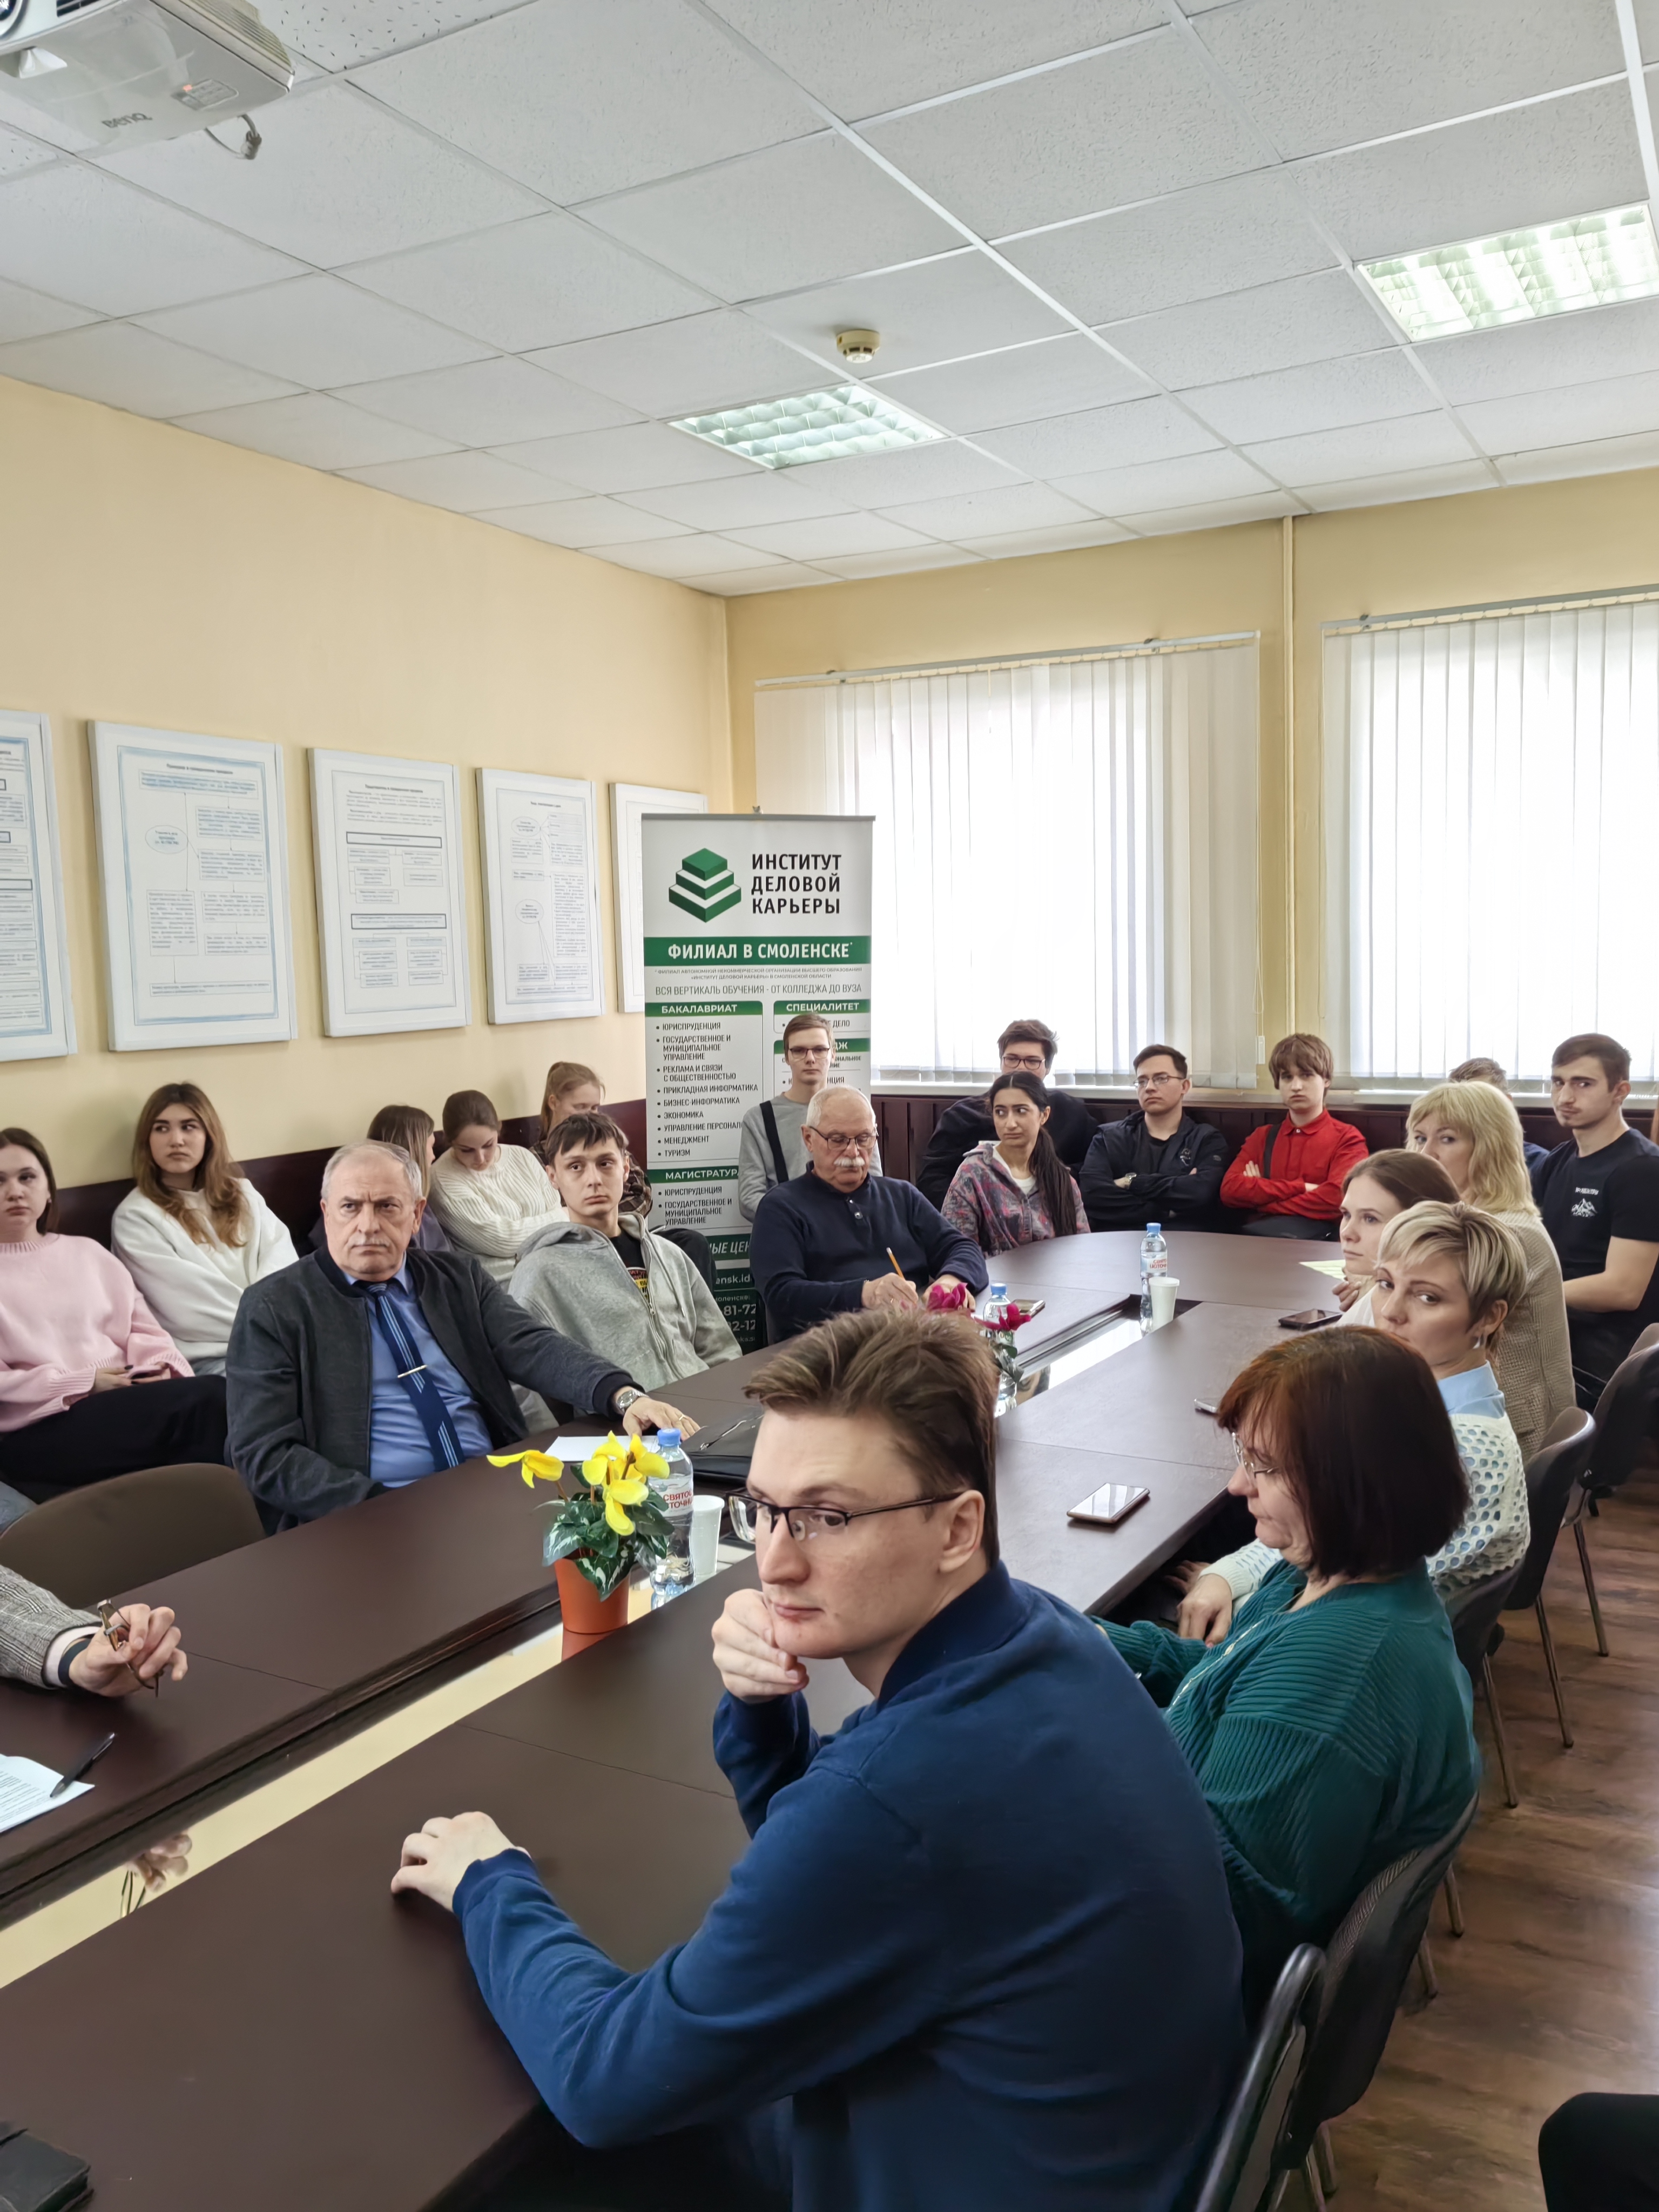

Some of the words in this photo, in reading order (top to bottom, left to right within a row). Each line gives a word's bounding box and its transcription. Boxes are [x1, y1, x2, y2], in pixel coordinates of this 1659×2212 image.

[101, 112, 152, 128] BenQ
[752, 854, 841, 870] ИНСТИТУТ
[751, 873, 840, 895] ДЕЛОВОЙ
[752, 898, 840, 914] КАРЬЕРЫ
[668, 944, 737, 959] ФИЛИАЛ
[744, 944, 752, 958] В
[656, 987, 671, 995] ВСЯ
[674, 986, 720, 995] ВЕРТИКАЛЬ
[723, 985, 764, 994] ОБУЧЕНИЯ
[771, 985, 781, 994] ОТ
[783, 984, 827, 994] КОЛЛЕДЖА
[829, 984, 840, 994] ДО
[842, 984, 861, 993] ВУЗА
[662, 1004, 738, 1014] БАКАЛАВРИАТ
[786, 1003, 859, 1013] СПЕЦИАЛИТЕТ
[662, 1022, 721, 1031] ЮРИСПРУДЕНЦИЯ
[663, 1035, 725, 1044] ГОСУДАРСТВЕННОЕ
[663, 1043, 721, 1053] МУНИЦИПАЛЬНОЕ
[663, 1053, 705, 1061] УПРАВЛЕНИЕ
[670, 1073, 736, 1082] ОБЩЕСТВЕННОСТЬЮ
[664, 1085, 708, 1094] ПРИКЛАДНАЯ
[709, 1084, 758, 1092] ИНФОРМАТИКА
[664, 1097, 740, 1107] БИЗНЕС-ИНФОРМАТИКА
[664, 1111, 704, 1119] ЭКОНОМИКА
[664, 1123, 705, 1132] УПРАВЛЕНИЕ
[707, 1122, 743, 1130] ПЕРСОНАЛ
[664, 1135, 710, 1145] МЕНЕДЖМЕНТ
[665, 1186, 722, 1196] ЮРИСПРУДЕНЦИЯ
[665, 1198, 726, 1209] ГОСУДАРСТВЕННОЕ
[665, 1208, 722, 1217] МУНИЦИПАЛЬНОЕ
[665, 1217, 706, 1226] УПРАВЛЕНИЕ
